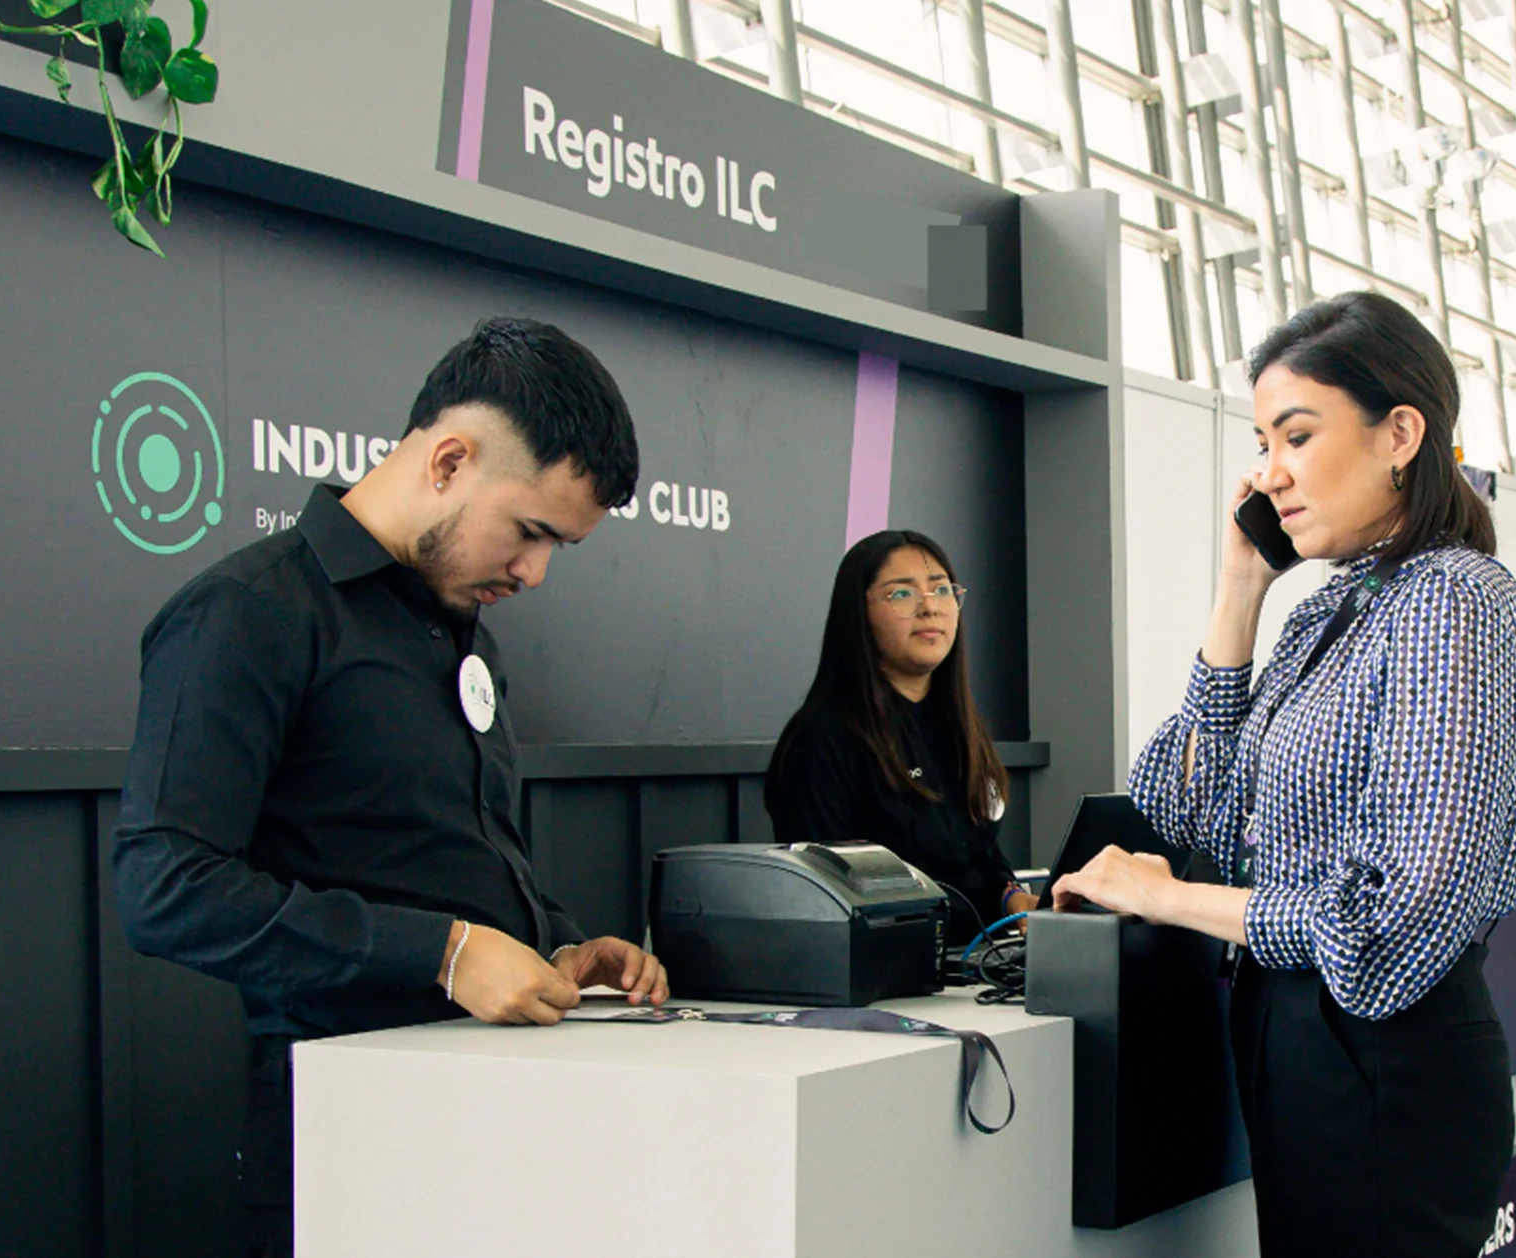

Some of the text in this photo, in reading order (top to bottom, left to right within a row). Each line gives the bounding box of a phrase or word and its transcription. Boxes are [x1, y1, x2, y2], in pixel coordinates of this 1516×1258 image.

[523, 85, 777, 232] Registro ILC
[253, 418, 400, 483] INDUS
[649, 481, 731, 532] CLUB
[255, 507, 277, 535] By
